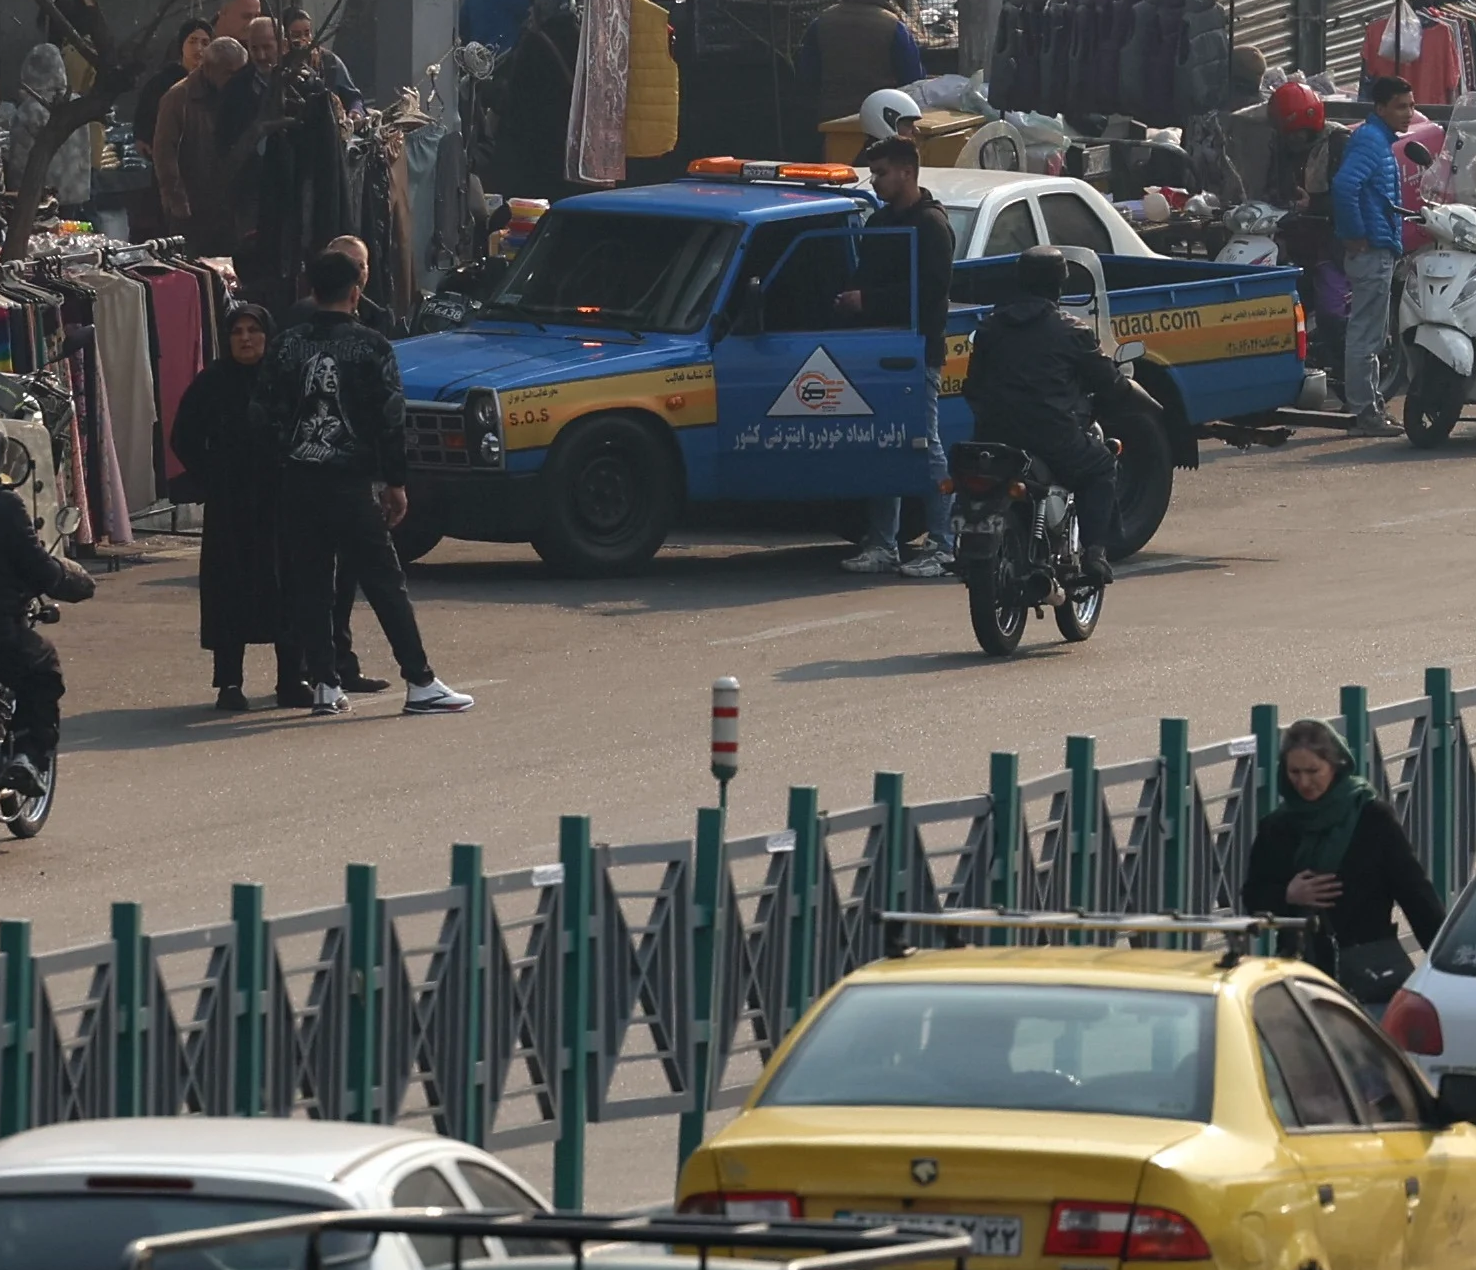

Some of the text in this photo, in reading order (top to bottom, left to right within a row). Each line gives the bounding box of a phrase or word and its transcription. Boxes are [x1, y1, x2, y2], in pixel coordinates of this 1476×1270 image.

[509, 409, 550, 426] S.O.S
[733, 422, 906, 450] اولین امداد خودرو اینترنتی کشور
